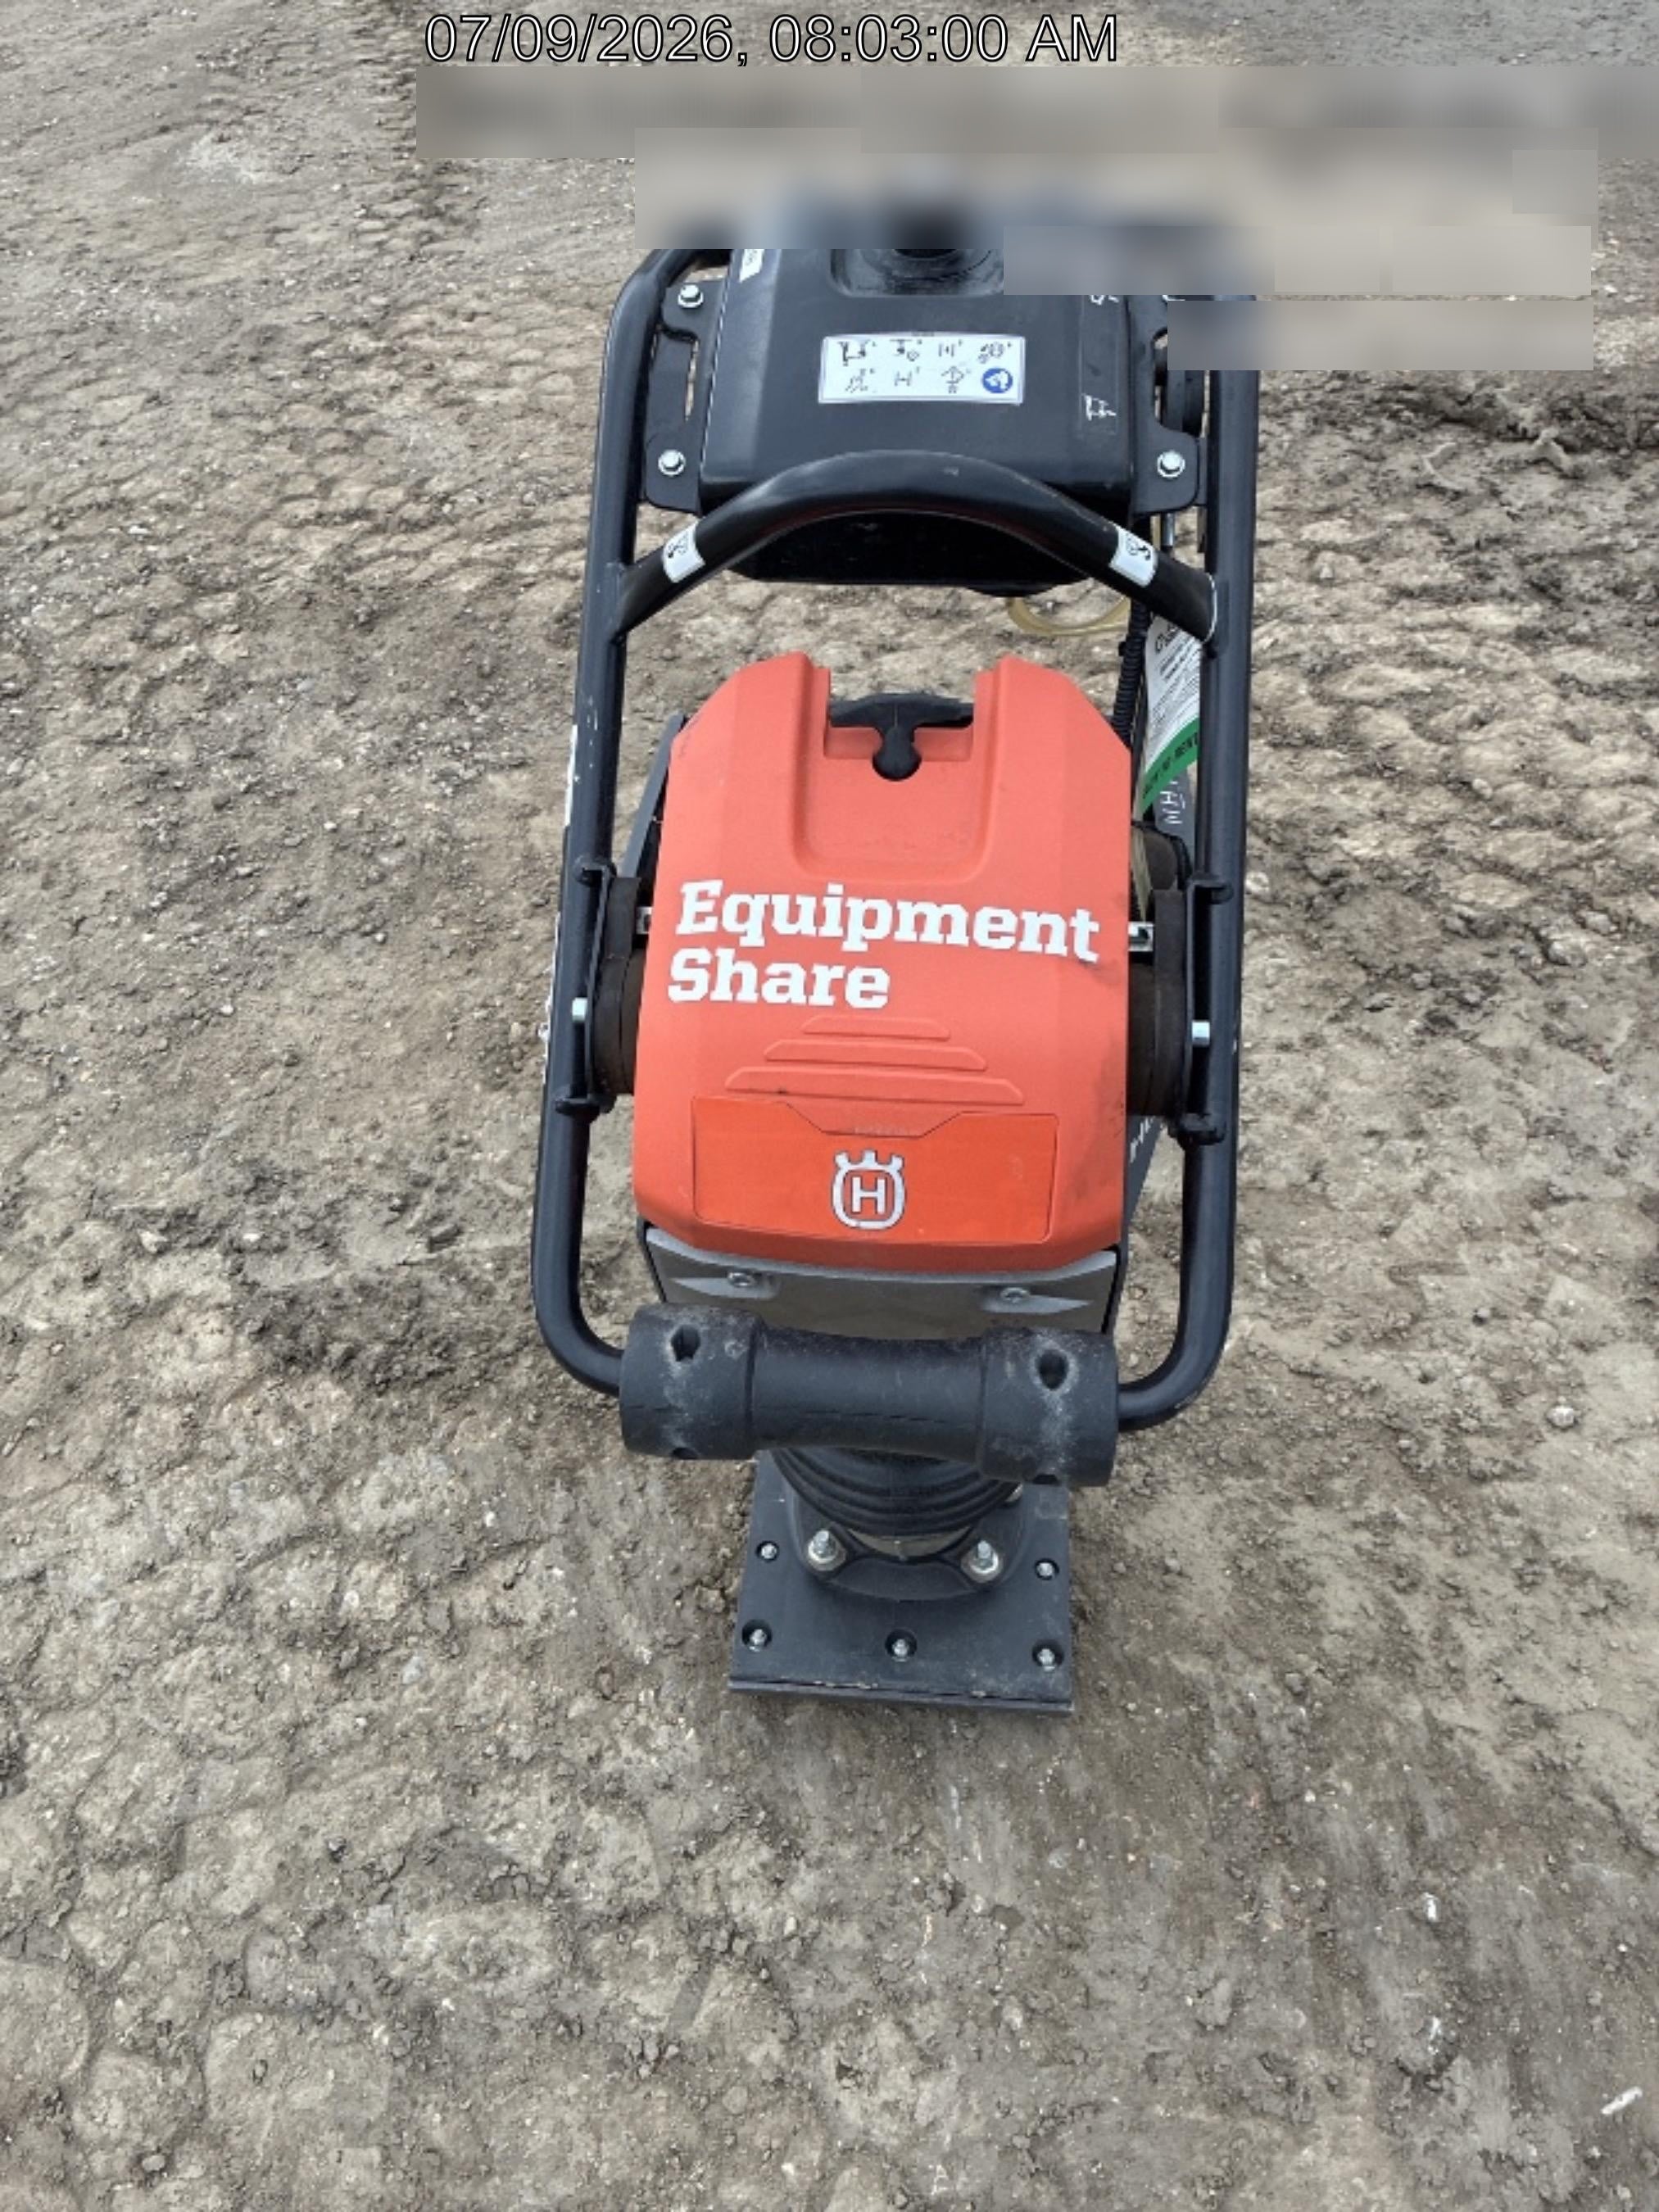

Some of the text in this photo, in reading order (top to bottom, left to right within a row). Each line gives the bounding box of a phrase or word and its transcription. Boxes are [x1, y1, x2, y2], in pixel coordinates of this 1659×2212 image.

[676, 880, 1099, 963] Equipment
[668, 947, 891, 1009] Share
[851, 1176, 886, 1215] H
